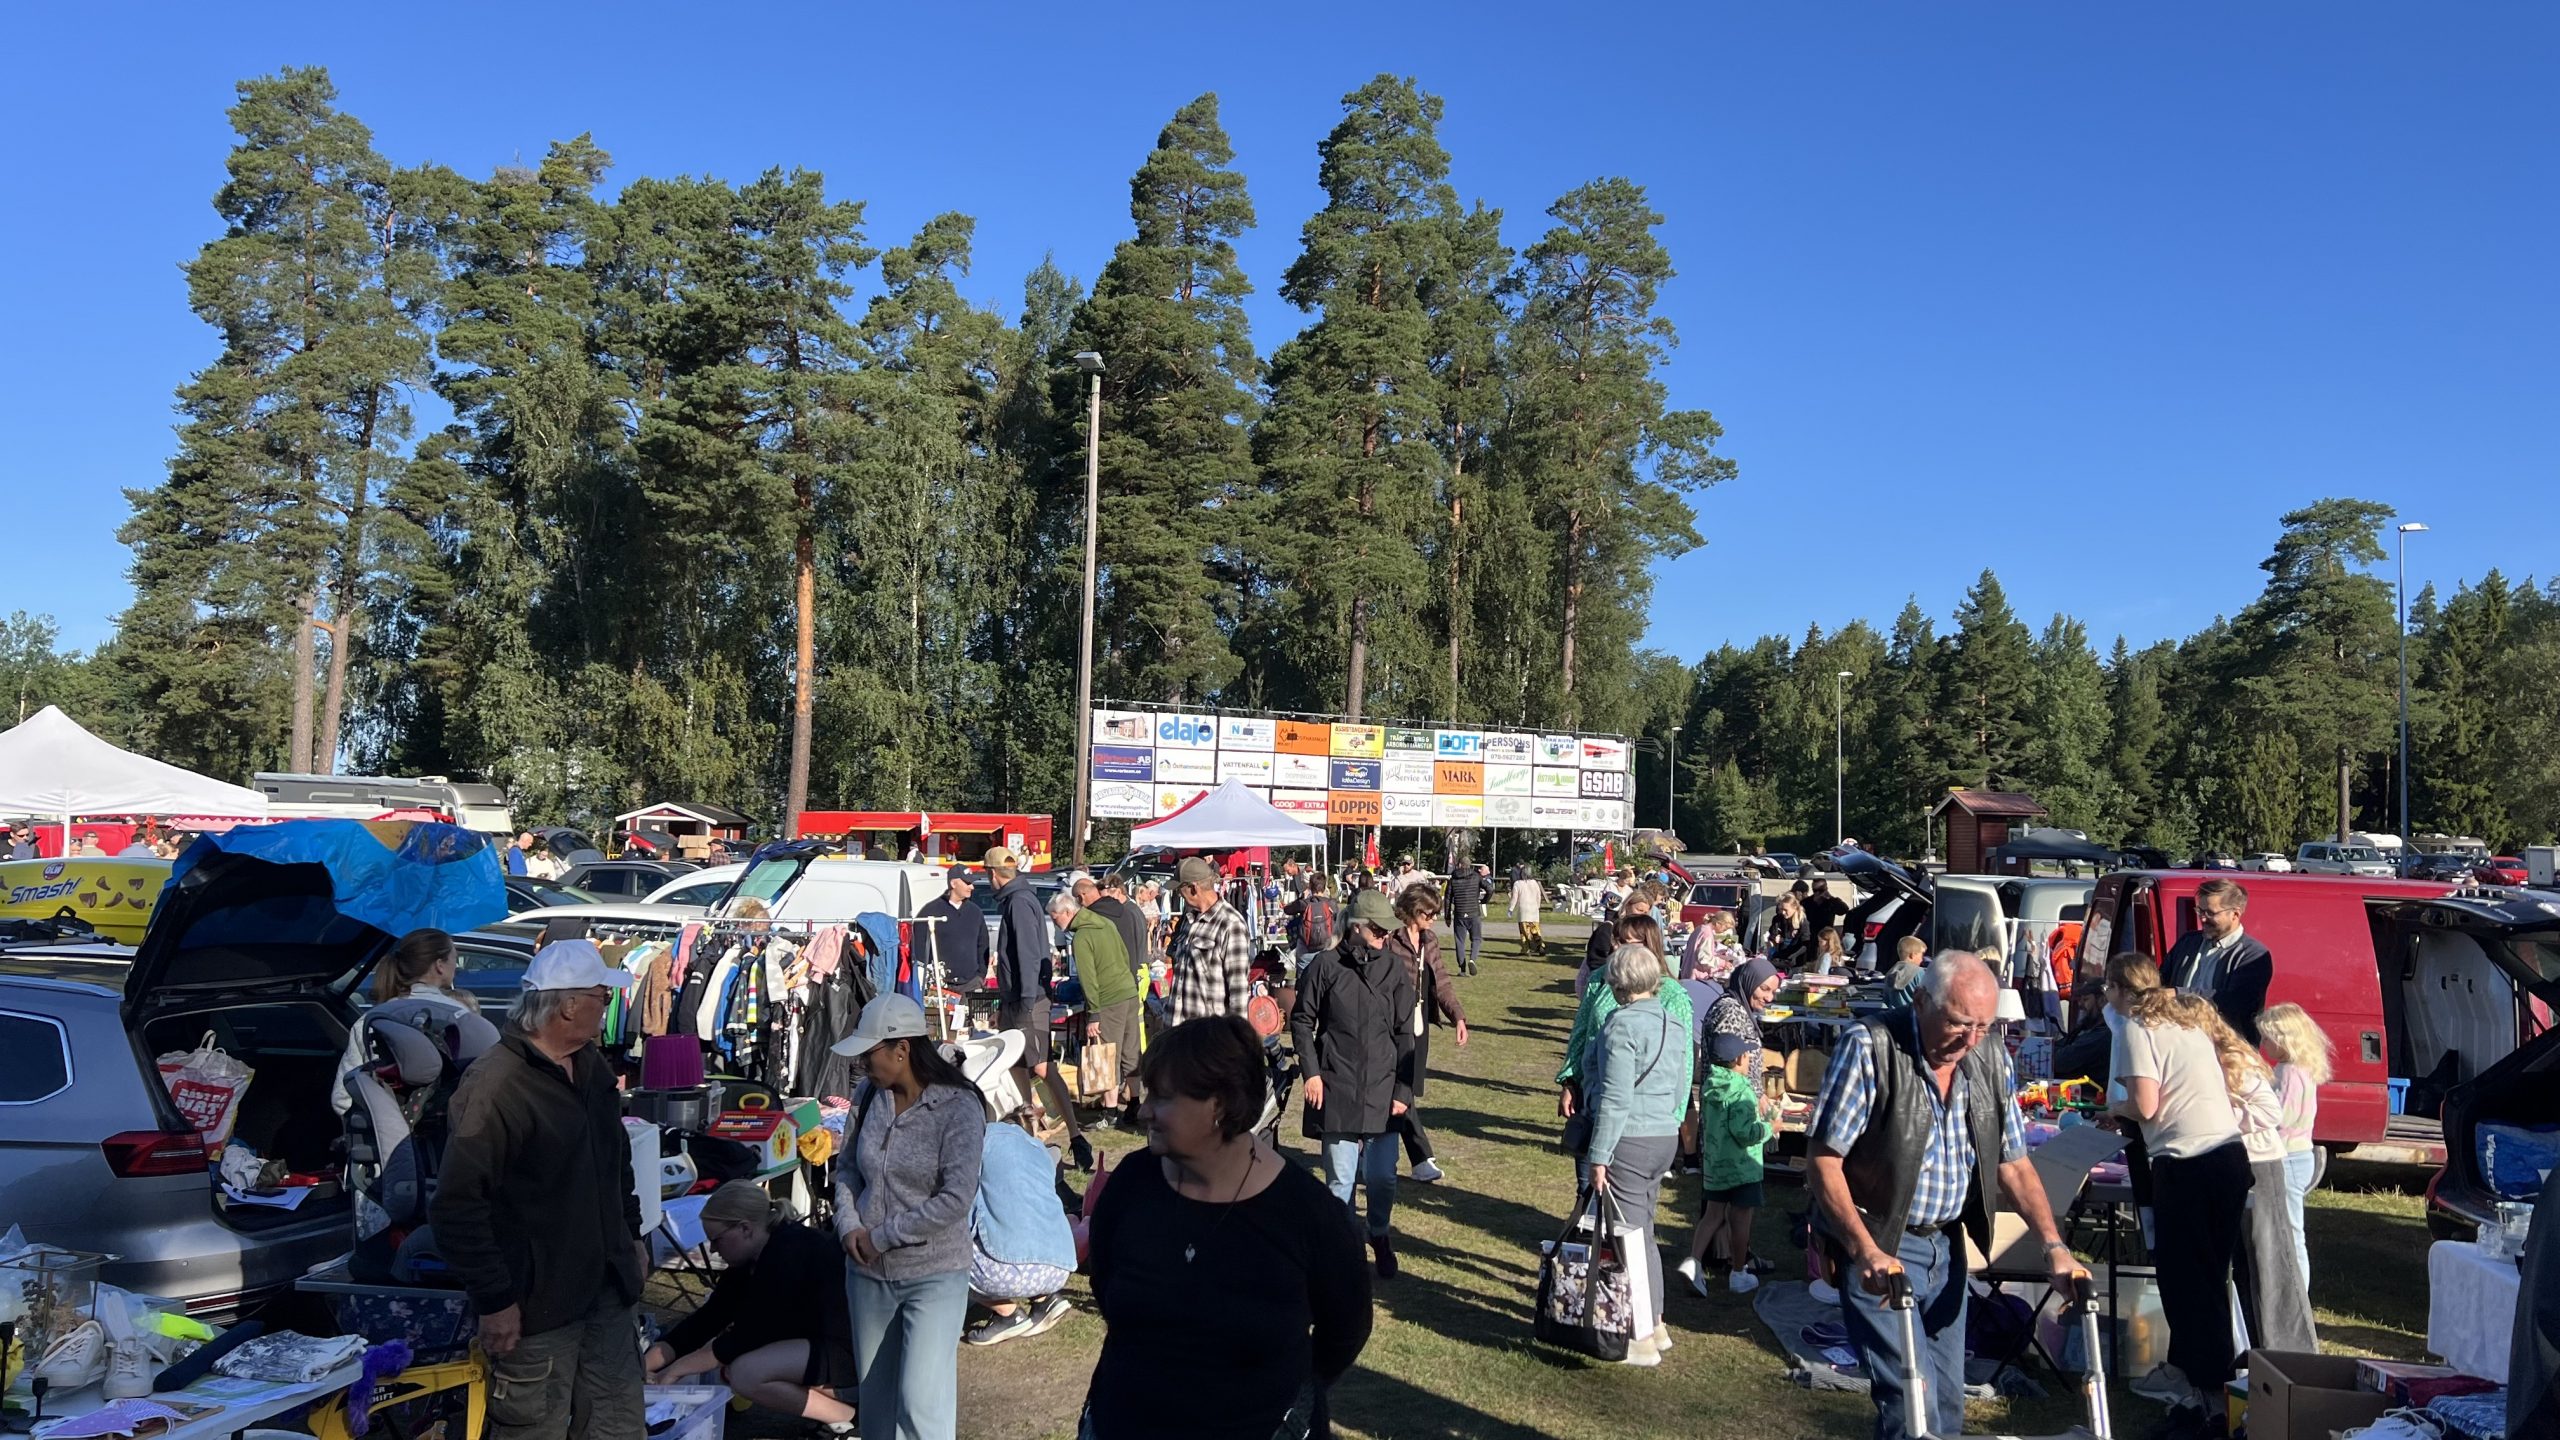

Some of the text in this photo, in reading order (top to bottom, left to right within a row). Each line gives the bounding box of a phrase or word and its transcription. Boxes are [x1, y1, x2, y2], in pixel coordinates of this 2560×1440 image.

[1159, 716, 1214, 746] elajo
[1137, 756, 1151, 765] AB
[1223, 761, 1261, 769] VATTENFALL
[1442, 770, 1476, 783] MARK
[1581, 771, 1624, 793] GSAB
[1274, 801, 1326, 809] COOP EXTRA
[1331, 800, 1379, 815] LOPPIS
[1399, 799, 1431, 807] AUGUST
[7, 876, 82, 904] Smash!
